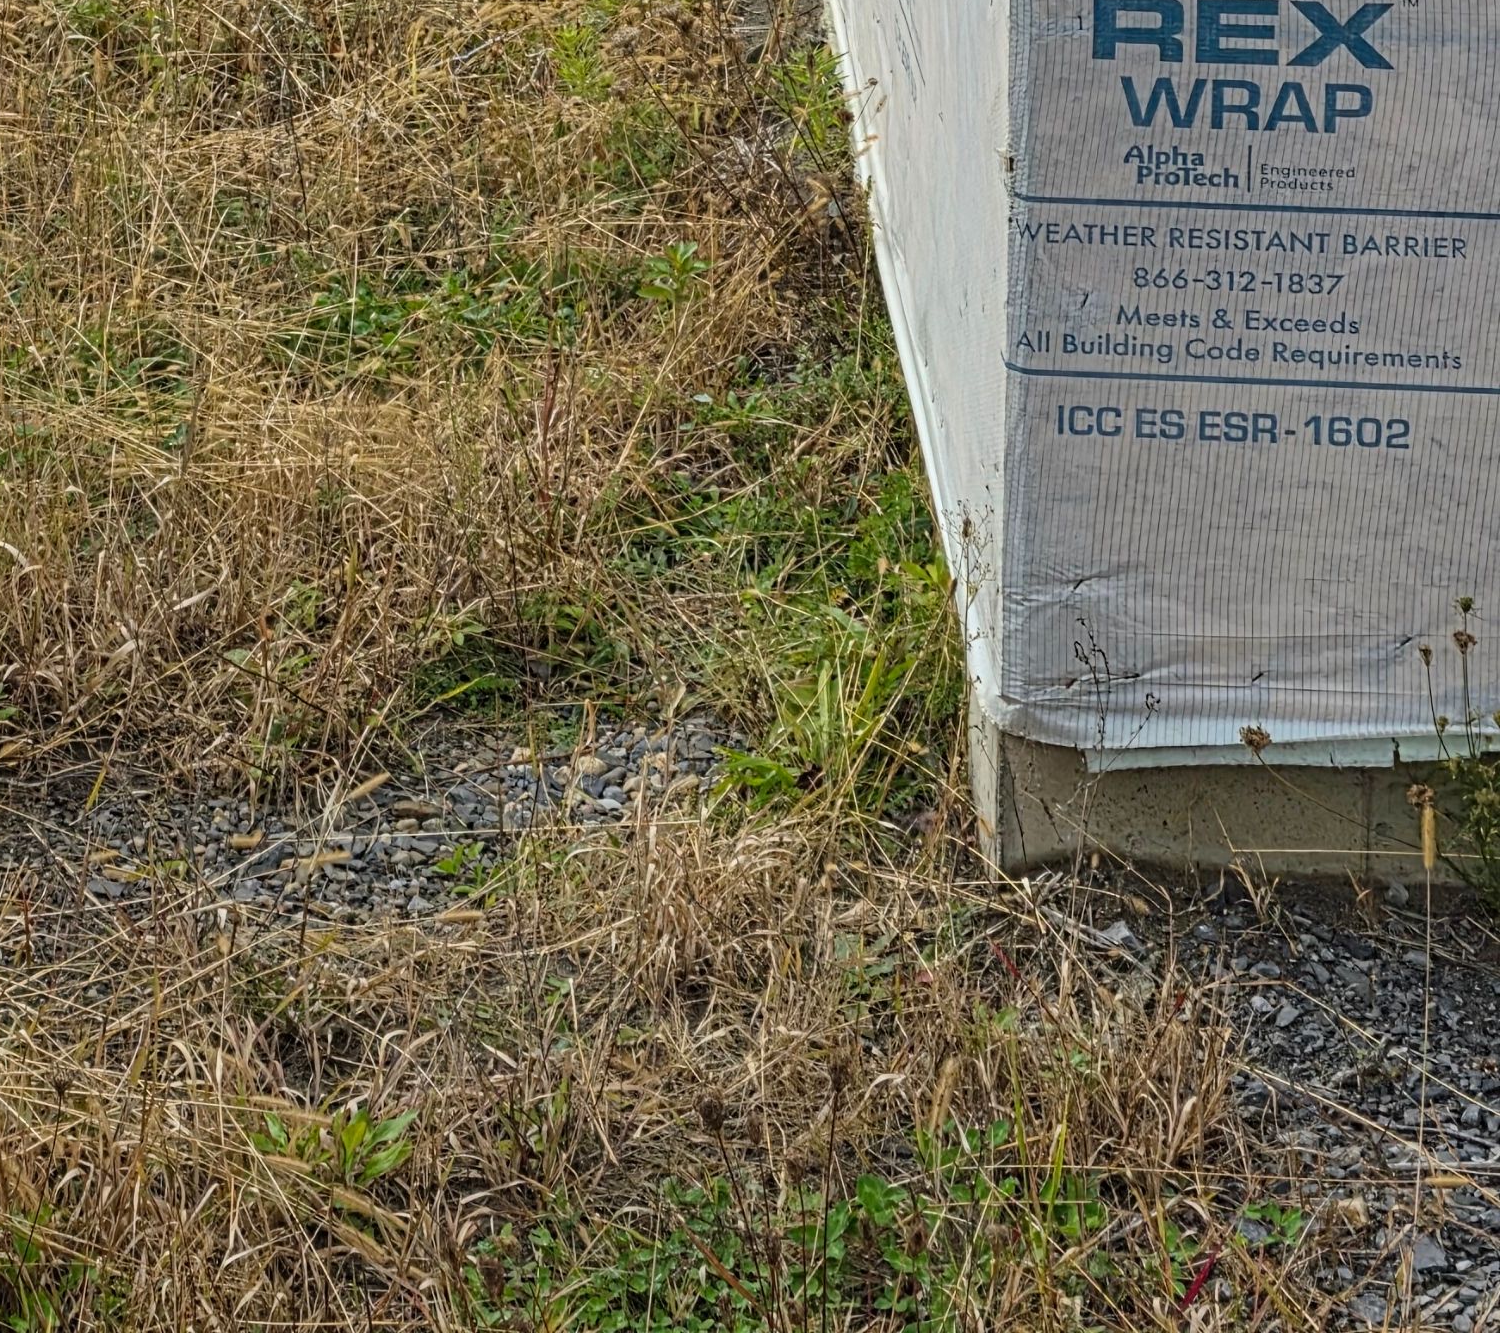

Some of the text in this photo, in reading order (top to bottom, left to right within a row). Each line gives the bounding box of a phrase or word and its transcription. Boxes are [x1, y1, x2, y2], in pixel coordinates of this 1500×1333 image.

[1120, 76, 1373, 134] WRAP
[1123, 144, 1204, 169] Alpha
[1260, 163, 1356, 179] Engineered
[1137, 165, 1240, 189] ProTech
[1260, 177, 1334, 192] Products
[1015, 218, 1468, 259] WEATHER RESISTANT BARRIER
[1133, 266, 1346, 295] 866-312-1837
[1116, 305, 1360, 335] Meets & Exceeds
[1016, 330, 1463, 371] All Building Code Requirements
[1057, 404, 1122, 437] ICC
[1135, 408, 1186, 441] ES
